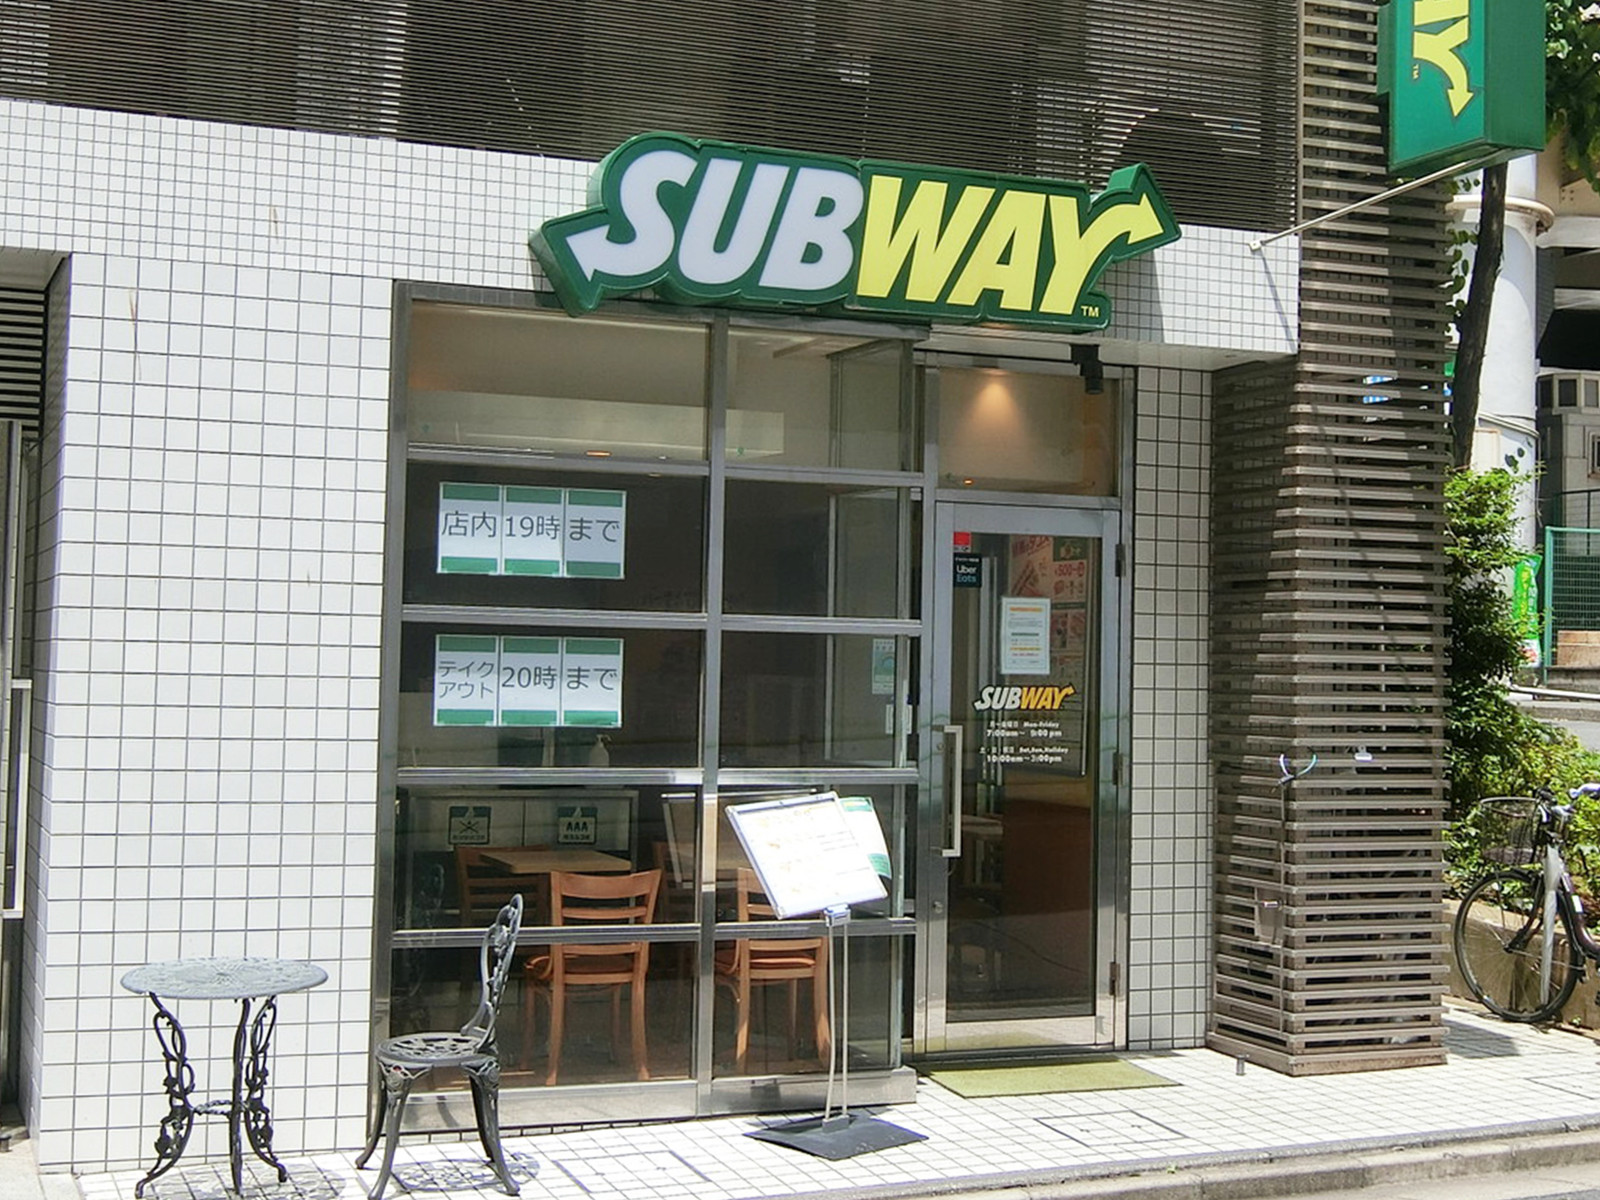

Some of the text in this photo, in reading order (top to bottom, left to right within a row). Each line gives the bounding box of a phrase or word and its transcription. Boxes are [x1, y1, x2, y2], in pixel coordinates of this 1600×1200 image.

[566, 149, 1165, 315] SUBWAY
[956, 564, 977, 574] Uber
[438, 660, 495, 678] テイク
[438, 681, 494, 699] アウト
[973, 684, 1075, 711] SUBWAY
